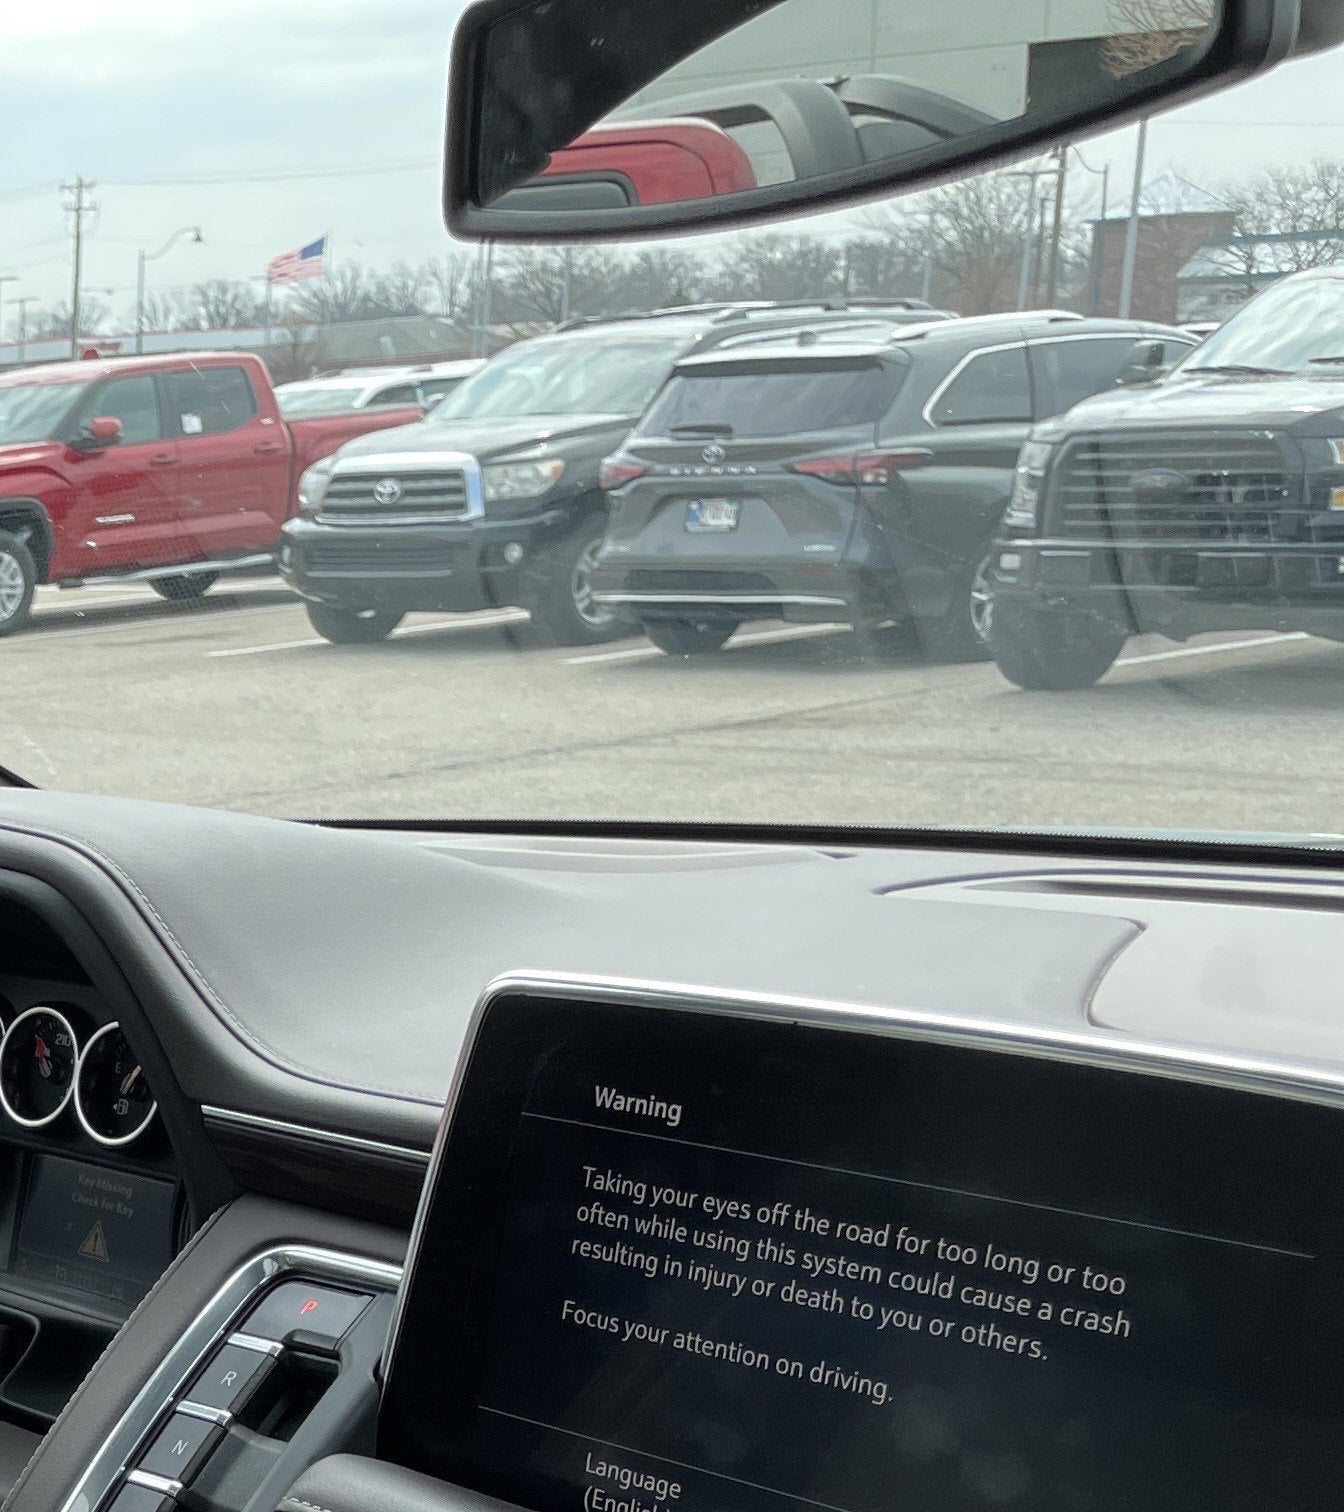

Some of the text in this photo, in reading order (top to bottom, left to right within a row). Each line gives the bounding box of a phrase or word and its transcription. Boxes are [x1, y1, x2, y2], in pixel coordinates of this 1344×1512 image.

[594, 1084, 683, 1127] Warning
[582, 1165, 1126, 1295] Taking your eyes off the road for too long or too
[576, 1201, 1131, 1338] often while using this system could cause a crash
[300, 1300, 318, 1314] P
[571, 1239, 1048, 1361] resulting in injury or death to you or others.
[561, 1299, 893, 1406] Focus your attention on driving.
[220, 1371, 237, 1387] R
[171, 1440, 189, 1456] N
[585, 1451, 682, 1501] Language
